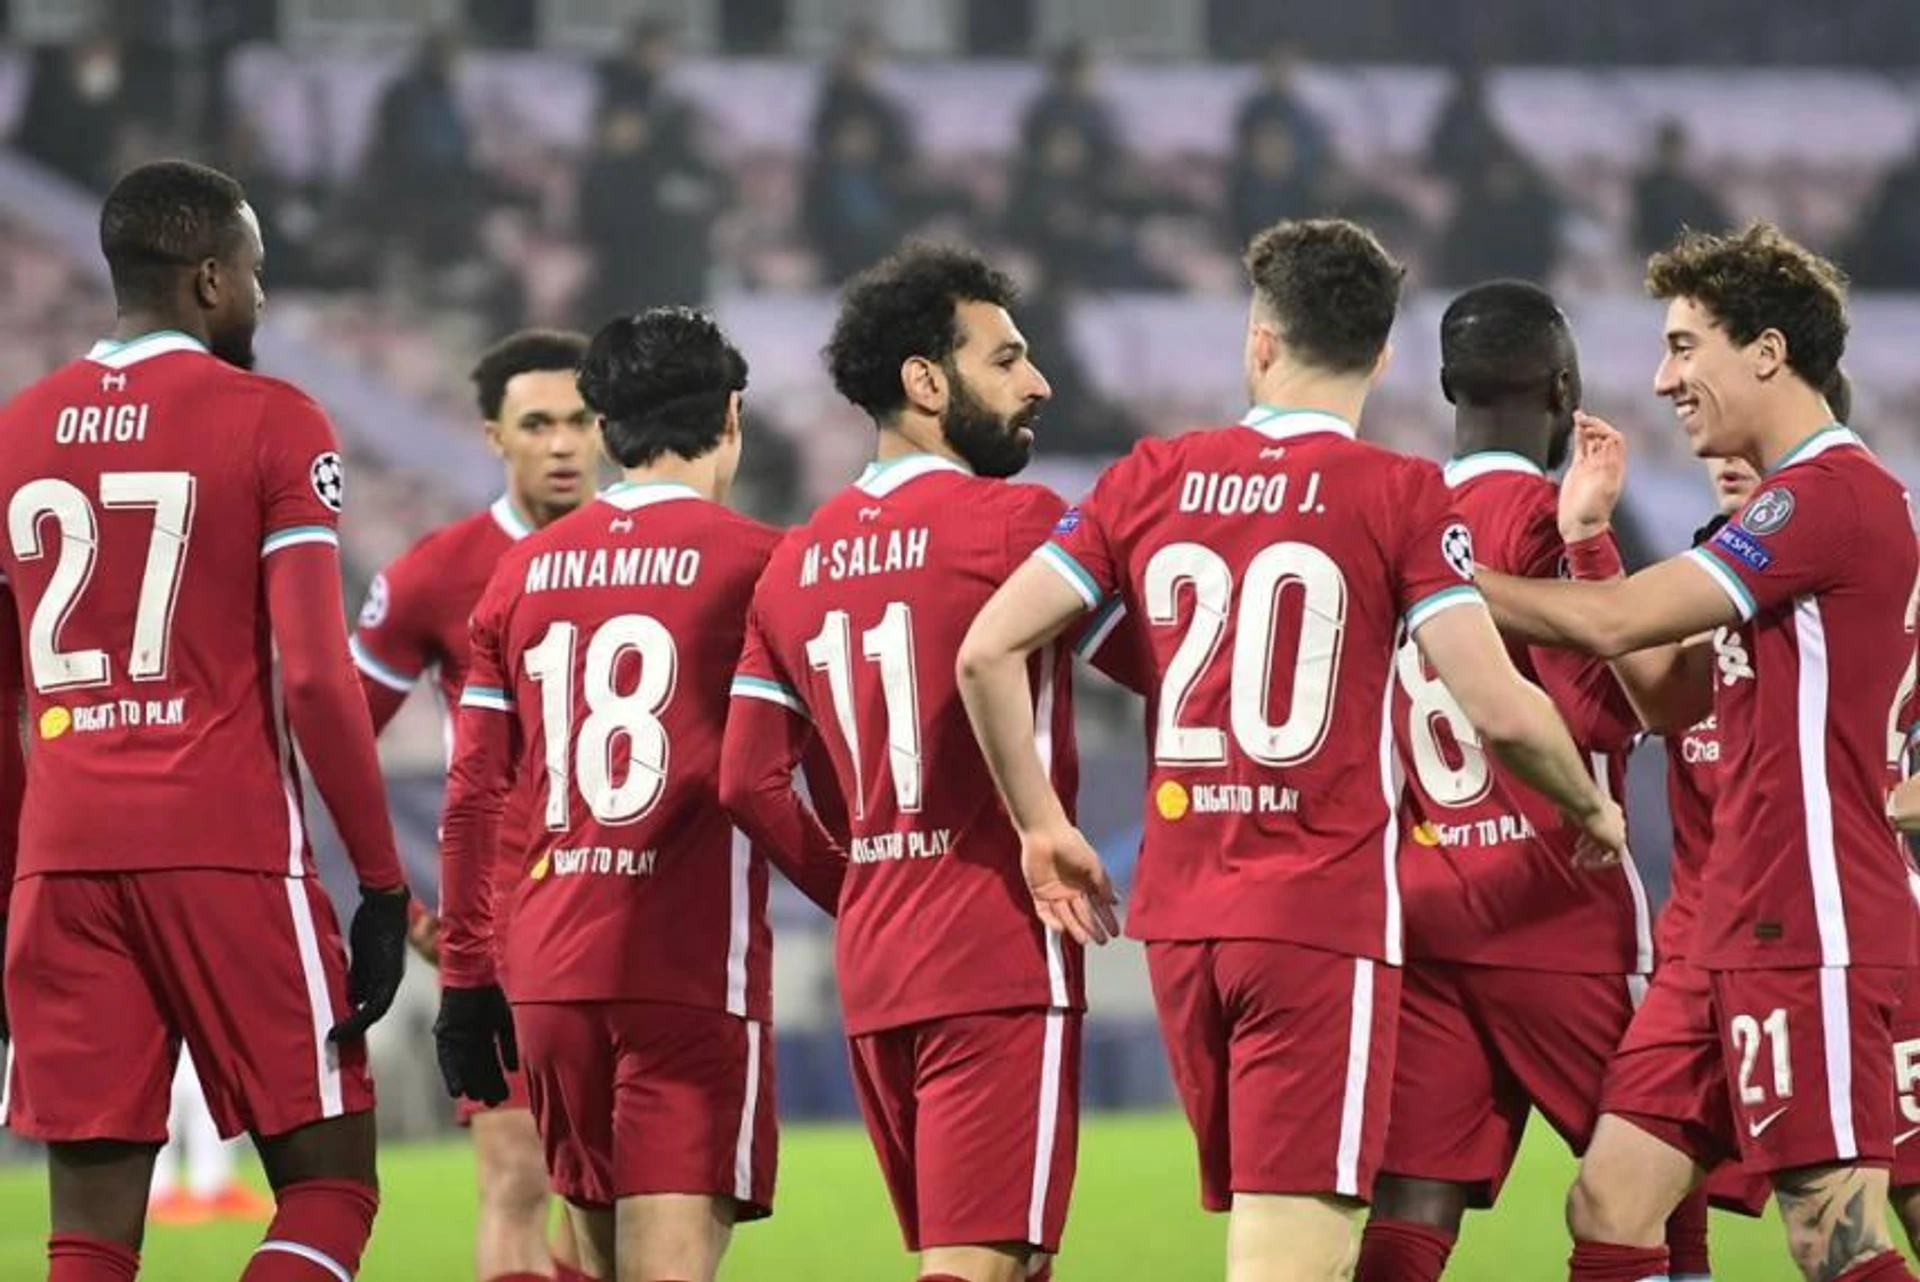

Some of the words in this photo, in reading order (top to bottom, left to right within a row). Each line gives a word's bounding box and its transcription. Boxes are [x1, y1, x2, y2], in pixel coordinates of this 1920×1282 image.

[56, 404, 149, 444] ORIGI
[1179, 471, 1286, 515] DIOGO
[1297, 472, 1326, 513] J.
[8, 471, 197, 694] 27
[525, 547, 700, 593] MINAMINO
[1144, 541, 1347, 766] 20
[118, 698, 140, 725] TO
[146, 698, 184, 727] PLAY
[523, 613, 677, 832] 18
[806, 602, 922, 820] 11
[1259, 784, 1299, 812] PLAY
[908, 828, 950, 860] PLAY
[1475, 819, 1499, 846] TO
[591, 847, 612, 874] TO
[615, 848, 658, 875] PLAY
[1731, 1009, 1793, 1104] 21
